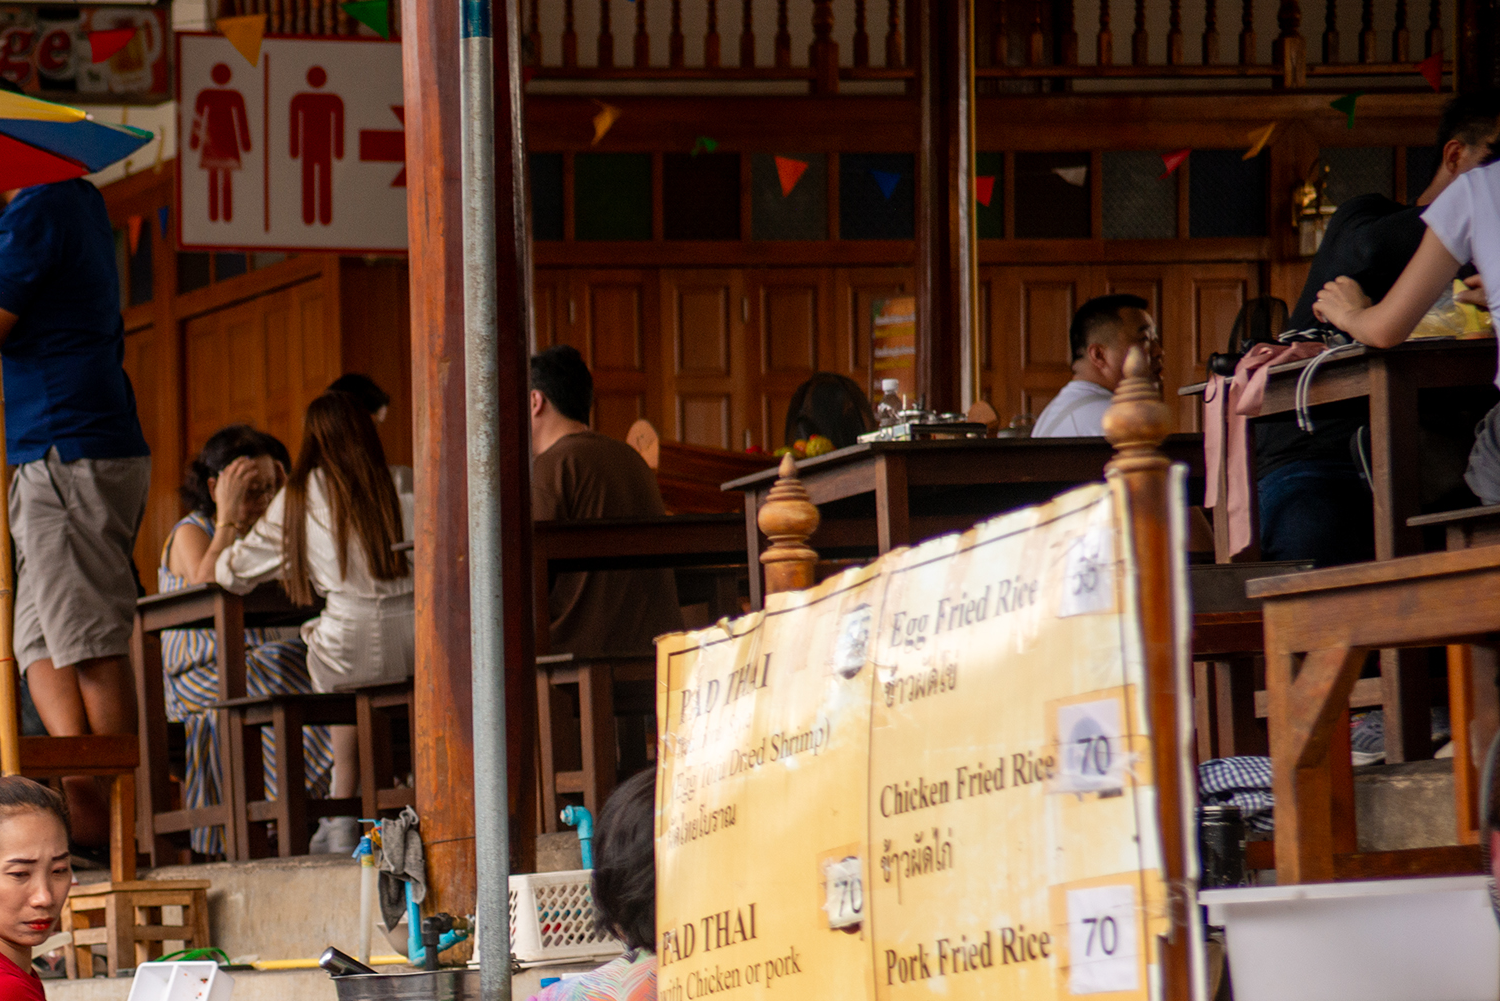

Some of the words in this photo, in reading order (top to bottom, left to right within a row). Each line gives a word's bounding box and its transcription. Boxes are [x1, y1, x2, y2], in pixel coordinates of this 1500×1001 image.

[889, 611, 929, 652] Egg
[934, 585, 991, 635] Fried
[995, 575, 1038, 618] Rice
[678, 679, 721, 725] PAD
[723, 652, 773, 707] THAI
[729, 736, 767, 777] Dried
[769, 716, 831, 763] Shrimp)
[1077, 735, 1111, 776] 70
[879, 777, 949, 819] Chicken
[956, 757, 1005, 800] Fried
[1011, 750, 1055, 788] Rice
[834, 878, 863, 917] 70
[660, 922, 695, 966] PAD
[701, 902, 758, 953] THAI
[884, 943, 931, 986] Pork
[936, 930, 993, 977] Fried
[1000, 924, 1051, 967] Rice
[1082, 915, 1119, 957] 70
[686, 965, 741, 1001] Chicken
[744, 962, 761, 986] or
[765, 945, 802, 989] pork
